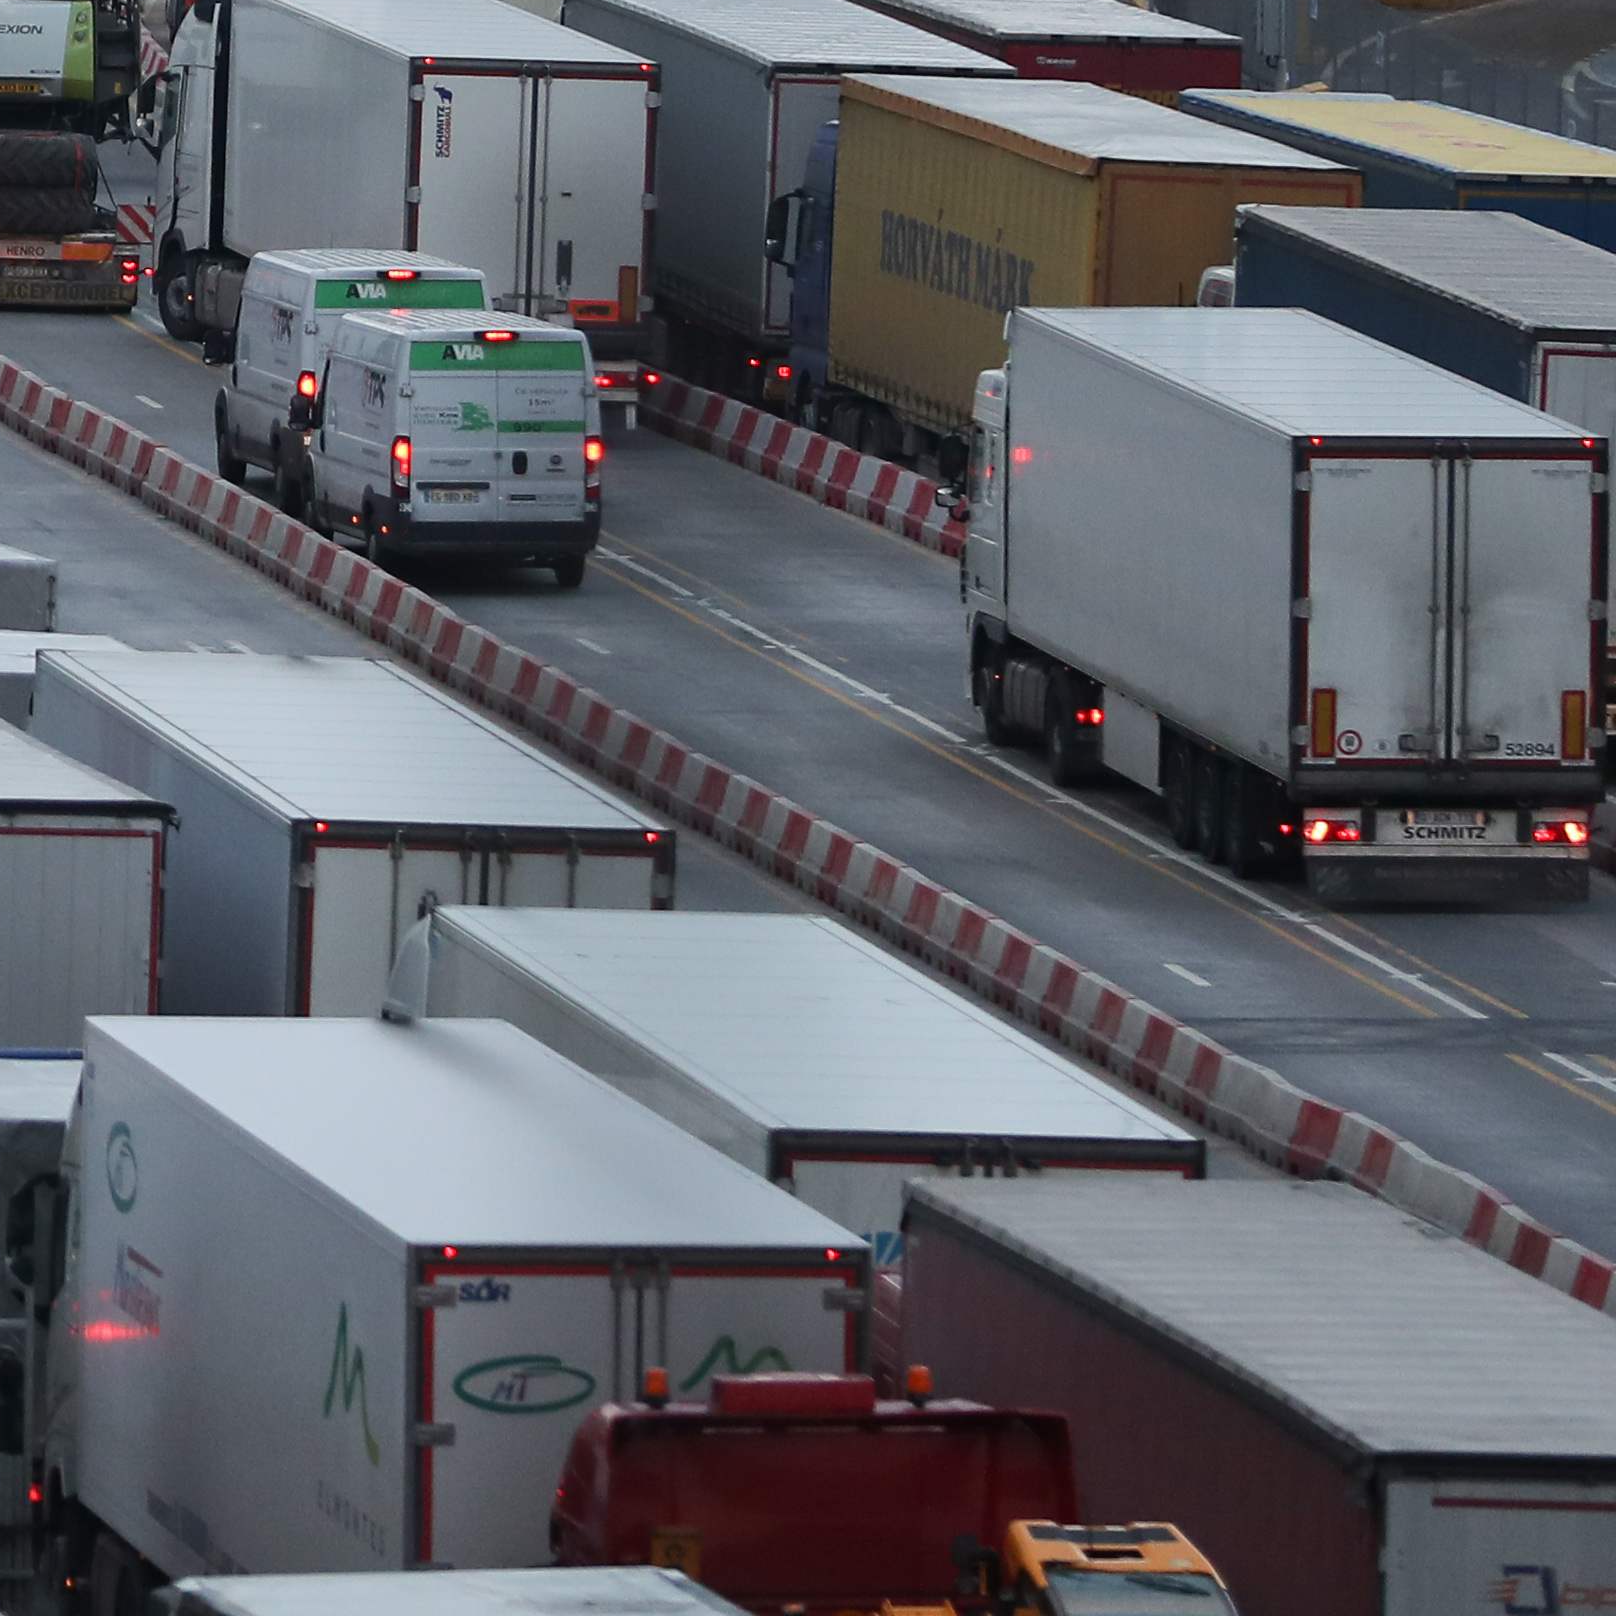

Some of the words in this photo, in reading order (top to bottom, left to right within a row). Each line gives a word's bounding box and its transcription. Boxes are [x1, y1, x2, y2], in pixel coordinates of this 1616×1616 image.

[435, 105, 446, 158] SCHMITZ
[5, 245, 46, 257] HENRO
[879, 208, 973, 301] HORVÁTH
[974, 228, 1035, 314] MÁRK
[345, 283, 386, 300] AVIA
[442, 344, 484, 361] AVIA
[1504, 743, 1556, 757] 52894
[1403, 826, 1487, 839] SCHMITZ
